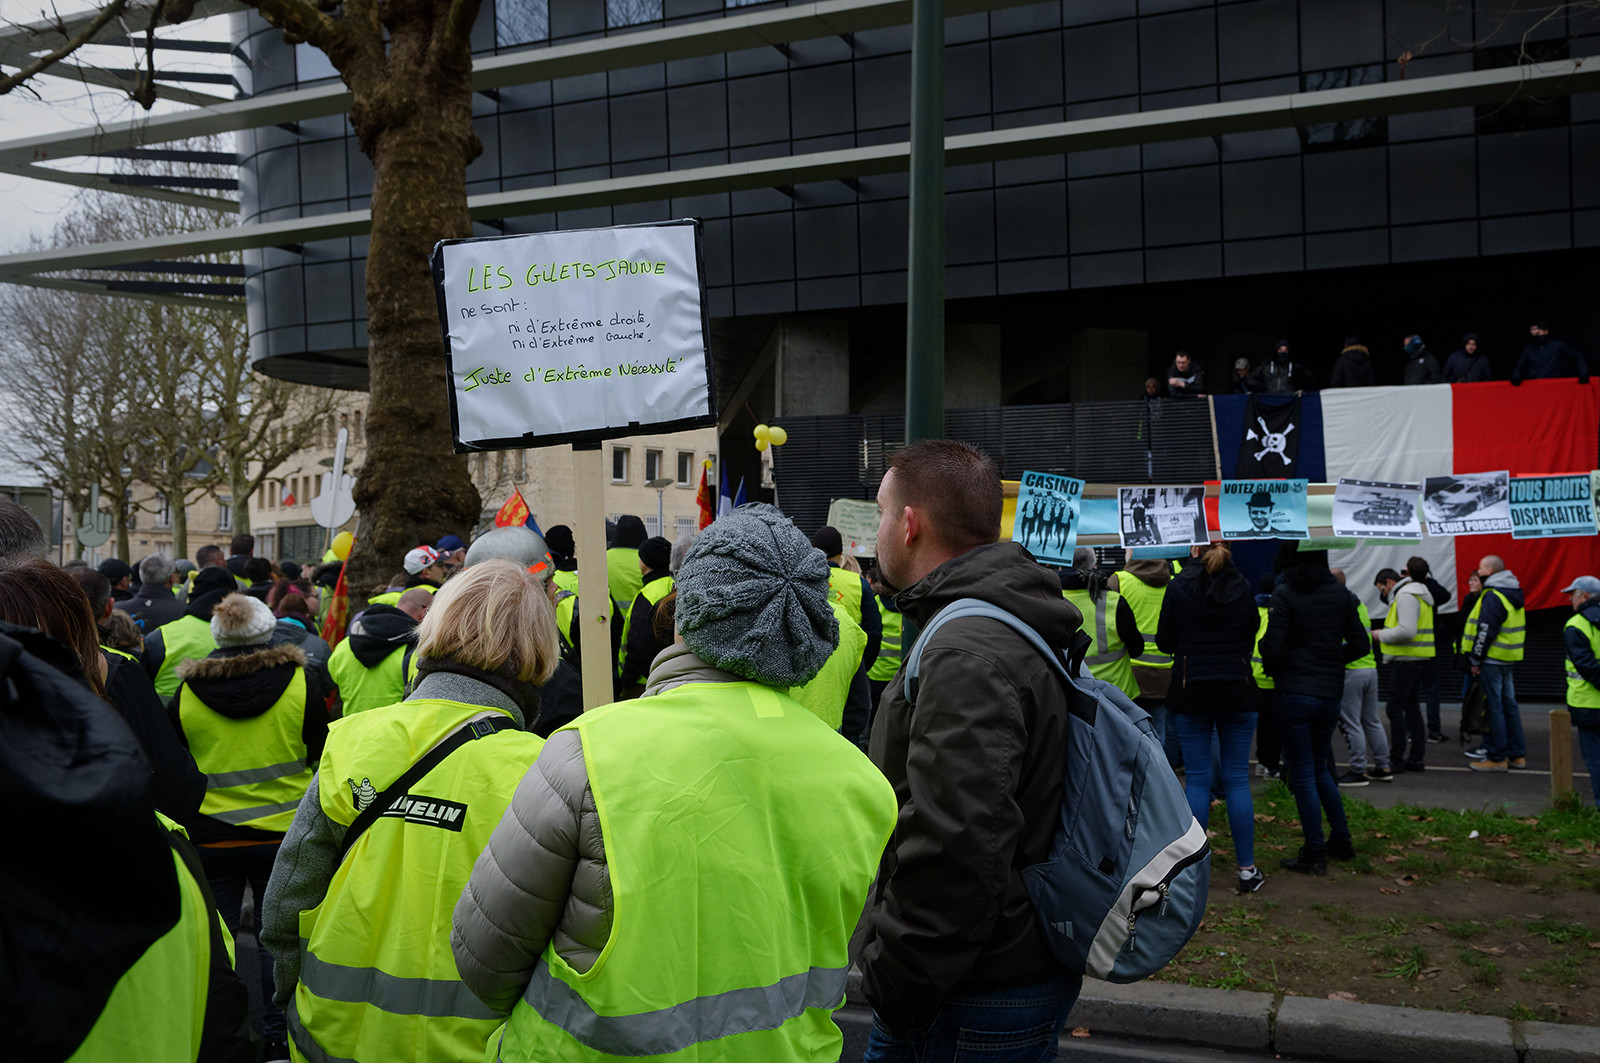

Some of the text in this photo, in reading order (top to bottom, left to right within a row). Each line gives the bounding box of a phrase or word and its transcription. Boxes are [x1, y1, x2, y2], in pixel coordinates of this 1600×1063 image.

[468, 265, 513, 293] LES
[597, 259, 666, 282] JAUNE
[460, 307, 477, 319] ne
[508, 320, 521, 335] ni
[464, 366, 512, 392] Juste
[1025, 473, 1080, 496] CASINO
[1224, 482, 1289, 495] VOTEZ GLAND
[1510, 480, 1543, 502] TOUS
[1544, 477, 1590, 500] DROITS
[1510, 505, 1593, 526] DISPARAITRE
[1430, 519, 1512, 534] JE SUIS PORSCHE
